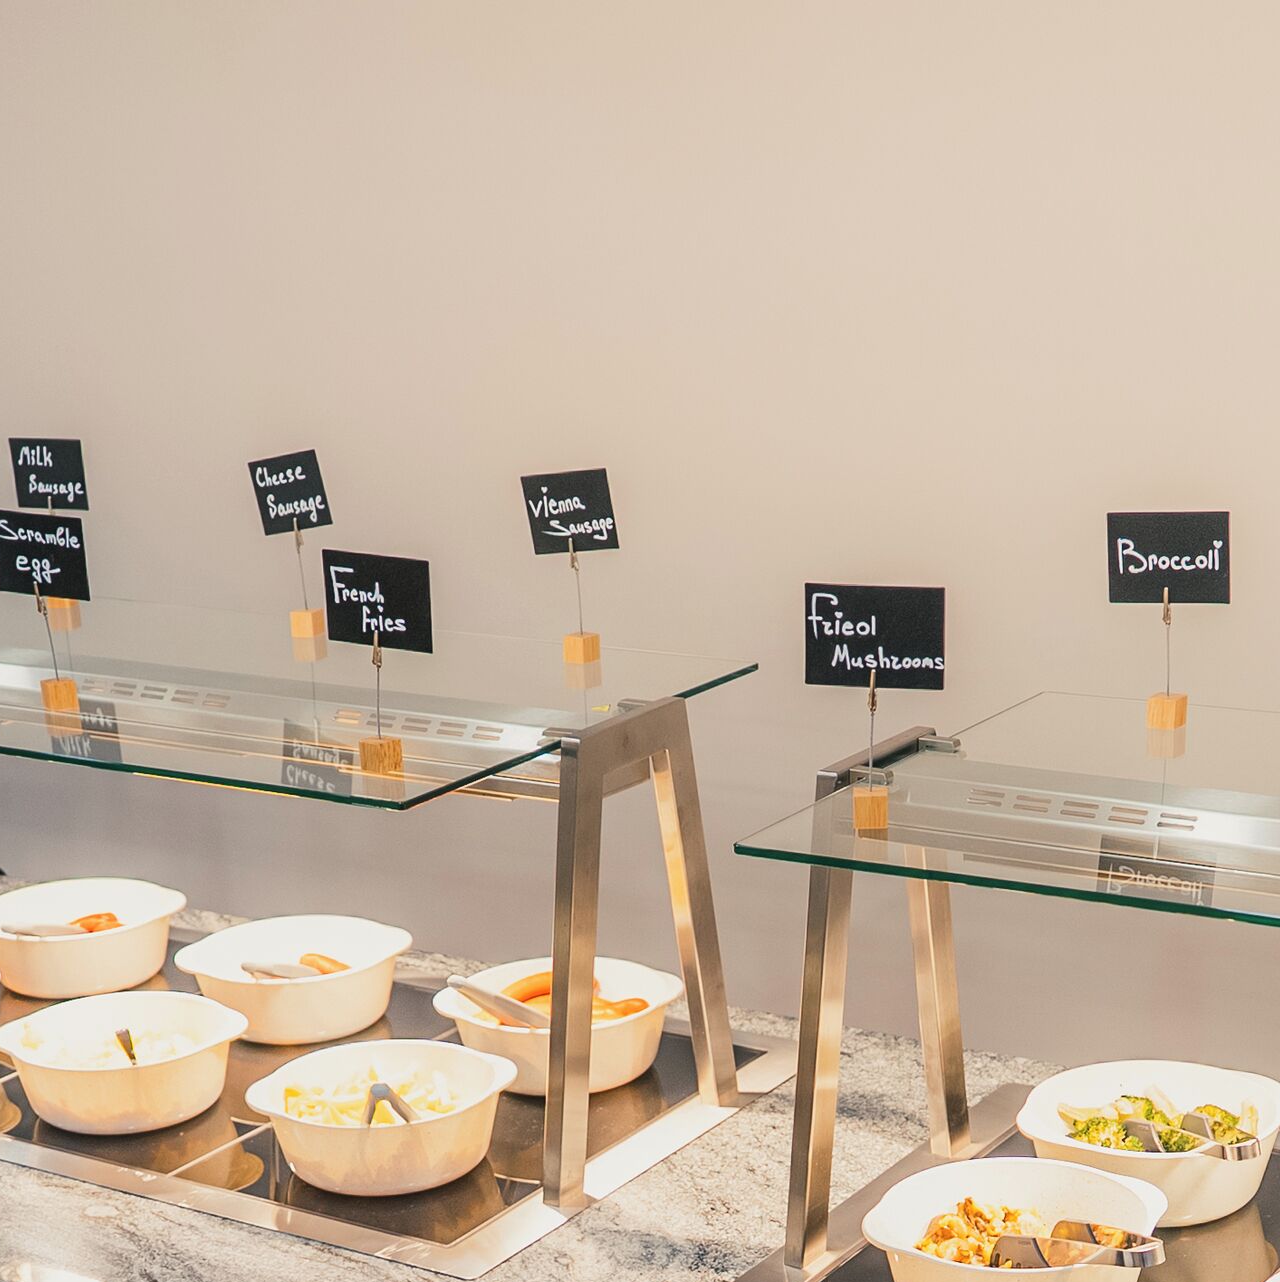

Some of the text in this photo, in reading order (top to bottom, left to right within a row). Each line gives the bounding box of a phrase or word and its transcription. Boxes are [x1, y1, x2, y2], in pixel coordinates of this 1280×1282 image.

[17, 445, 53, 467] Milk
[28, 473, 84, 503] Sausage
[255, 465, 306, 488] Cheese
[266, 493, 325, 523] Sausage
[541, 517, 614, 541] Sausage
[15, 555, 61, 584] egg
[1117, 537, 1222, 576] Broccoli
[329, 565, 384, 604] French
[831, 643, 945, 671] Mushrooms
